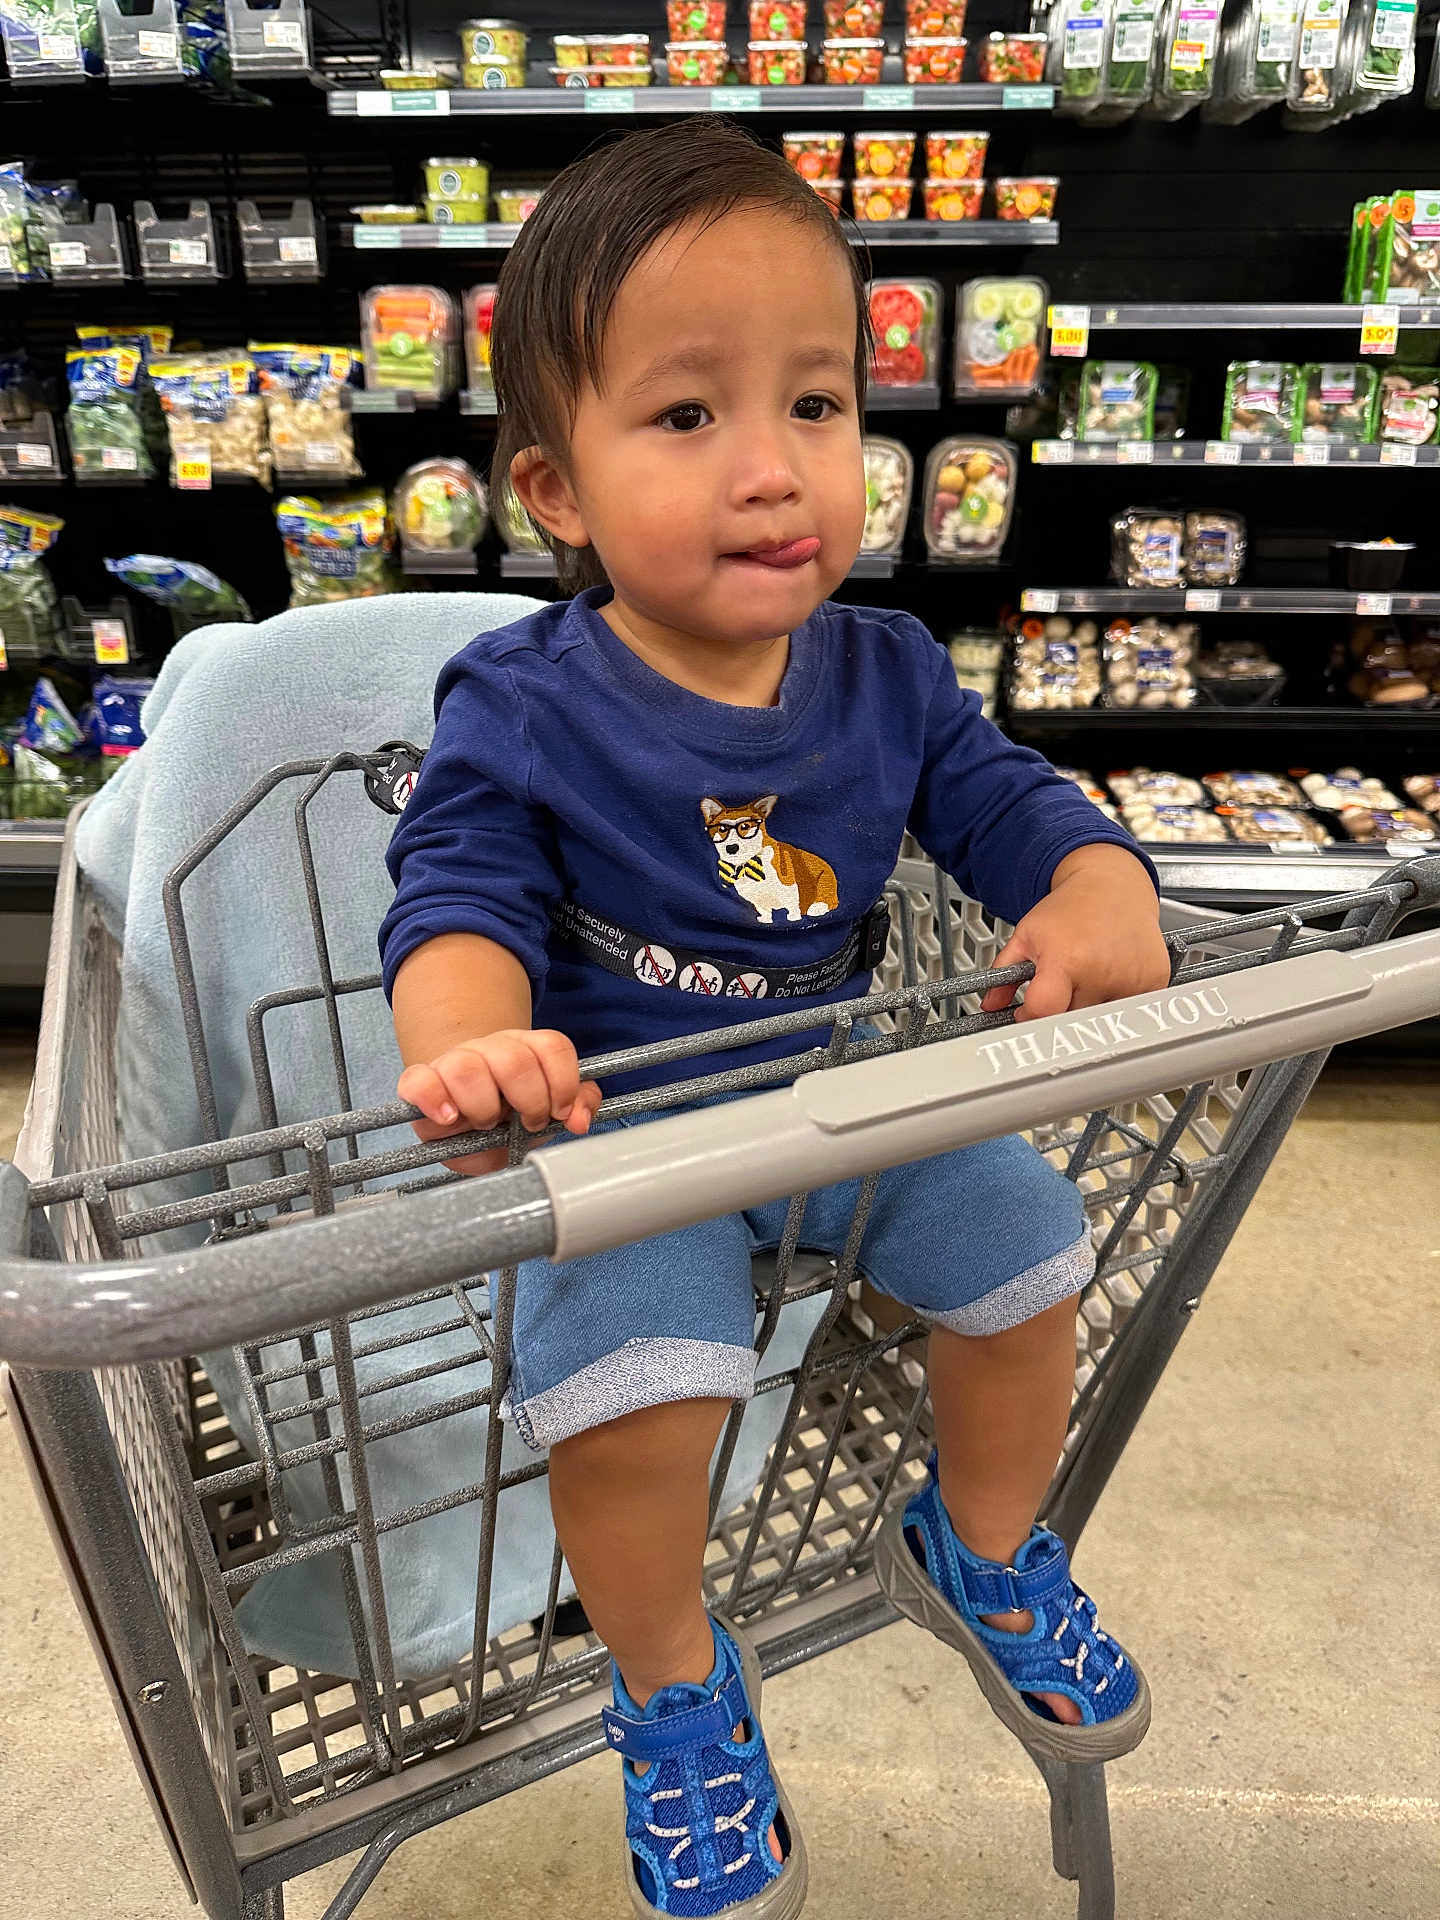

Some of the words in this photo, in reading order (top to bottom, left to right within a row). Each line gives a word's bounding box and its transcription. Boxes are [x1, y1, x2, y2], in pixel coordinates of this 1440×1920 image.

[565, 916, 629, 960] Unattended
[576, 908, 626, 943] Securely
[775, 987, 791, 998] Do
[793, 984, 810, 996] Not
[786, 970, 819, 984] Please
[976, 1010, 1142, 1074] THANK
[1137, 987, 1229, 1032] YOU
